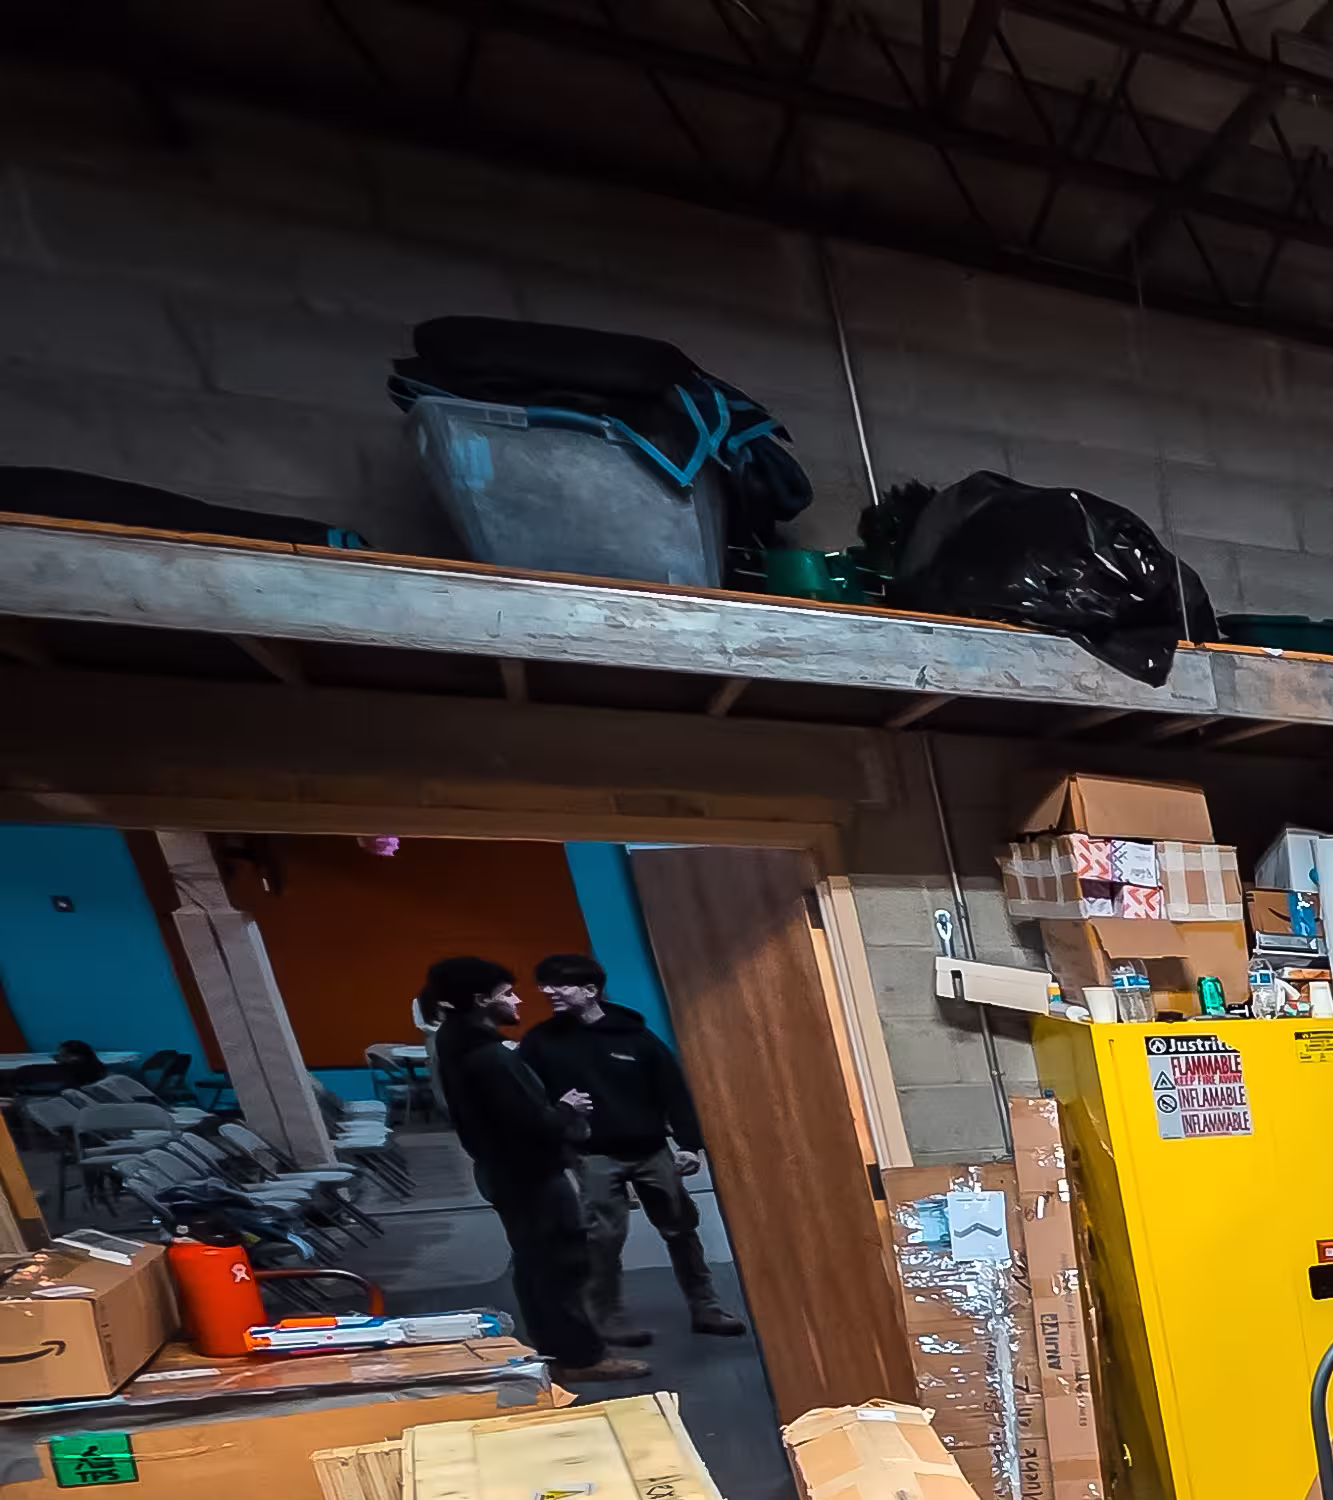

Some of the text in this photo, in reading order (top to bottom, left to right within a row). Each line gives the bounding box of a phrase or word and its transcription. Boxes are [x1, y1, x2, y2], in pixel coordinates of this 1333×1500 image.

[1170, 1055, 1242, 1076] FLAMMABLE
[1175, 1075, 1242, 1087] KEEP FIRE AWAY
[1178, 1086, 1246, 1109] INFLAMABLE
[1182, 1111, 1250, 1133] INFLAMMABLE
[76, 1469, 120, 1483] TPS
